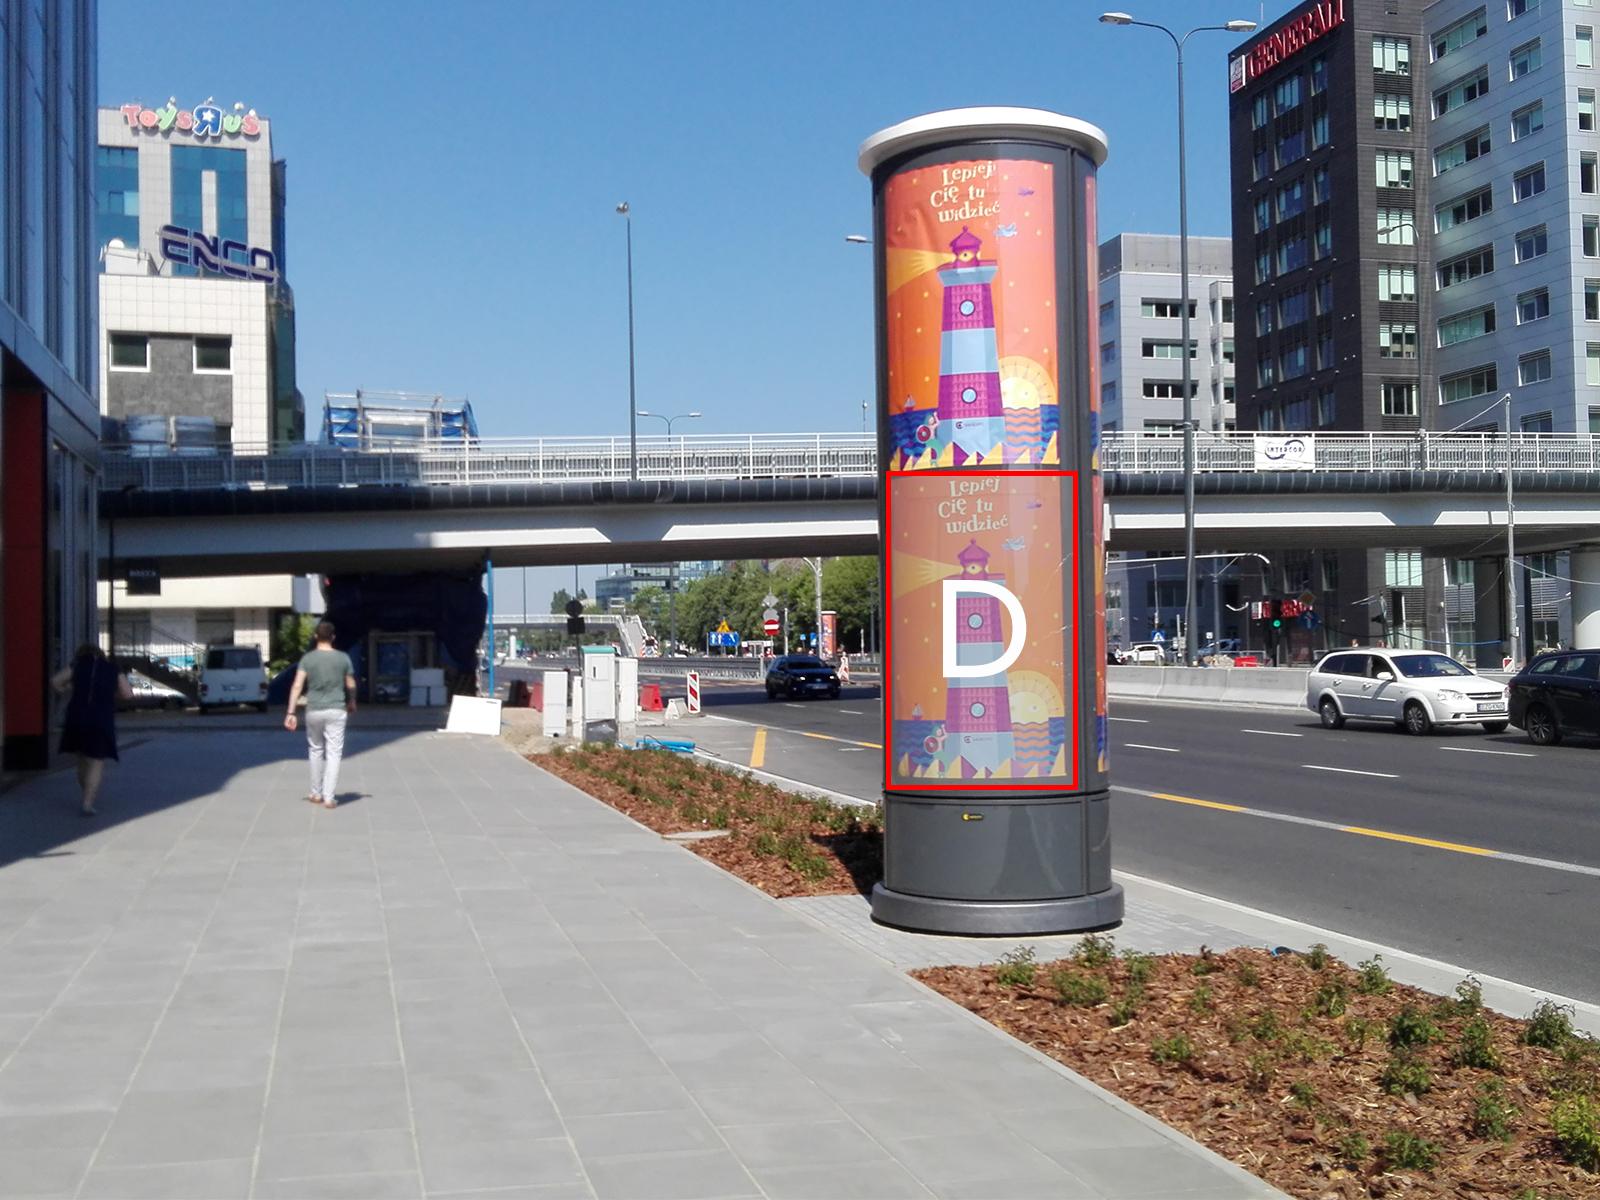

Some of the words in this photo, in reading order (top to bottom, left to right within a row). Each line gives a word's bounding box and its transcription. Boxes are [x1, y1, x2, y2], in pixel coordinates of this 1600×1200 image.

[1248, 0, 1346, 78] GENERALI
[942, 161, 993, 185] Lepiej
[929, 185, 959, 208] Cię
[967, 184, 986, 201] tu
[938, 200, 1001, 223] widzieć
[161, 224, 277, 284] ENCO
[948, 475, 1001, 497] Lepiej
[937, 497, 968, 519] Cię
[975, 497, 994, 513] tu
[945, 513, 1009, 534] widzieć
